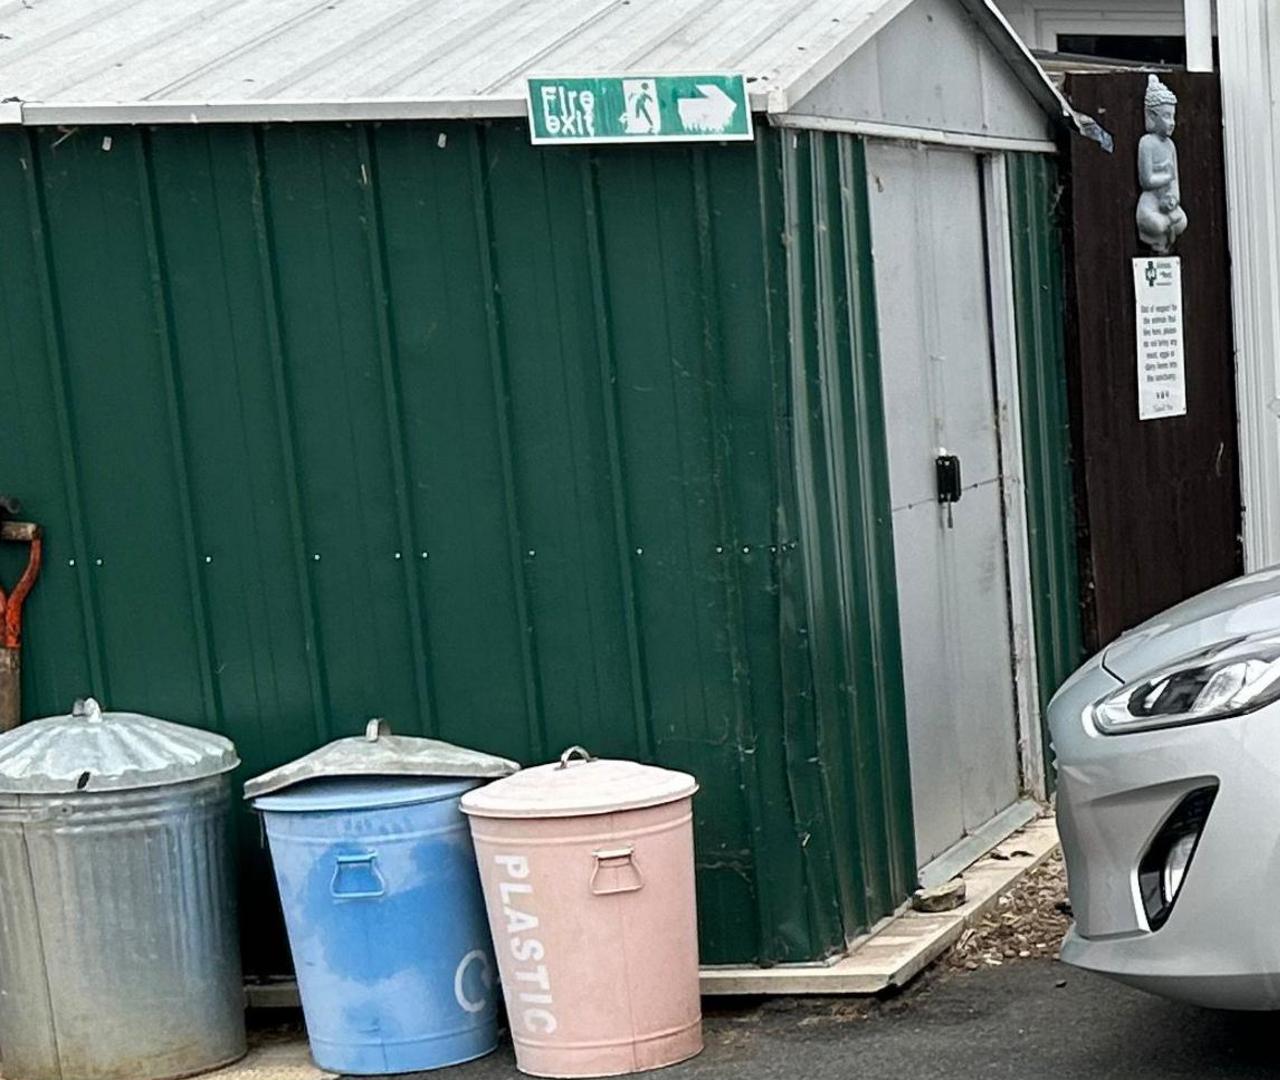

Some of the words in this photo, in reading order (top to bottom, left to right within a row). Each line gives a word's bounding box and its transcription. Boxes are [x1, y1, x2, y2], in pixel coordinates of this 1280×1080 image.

[541, 85, 595, 112] Fire
[544, 113, 595, 137] exit
[494, 854, 557, 1034] PLASTIC
